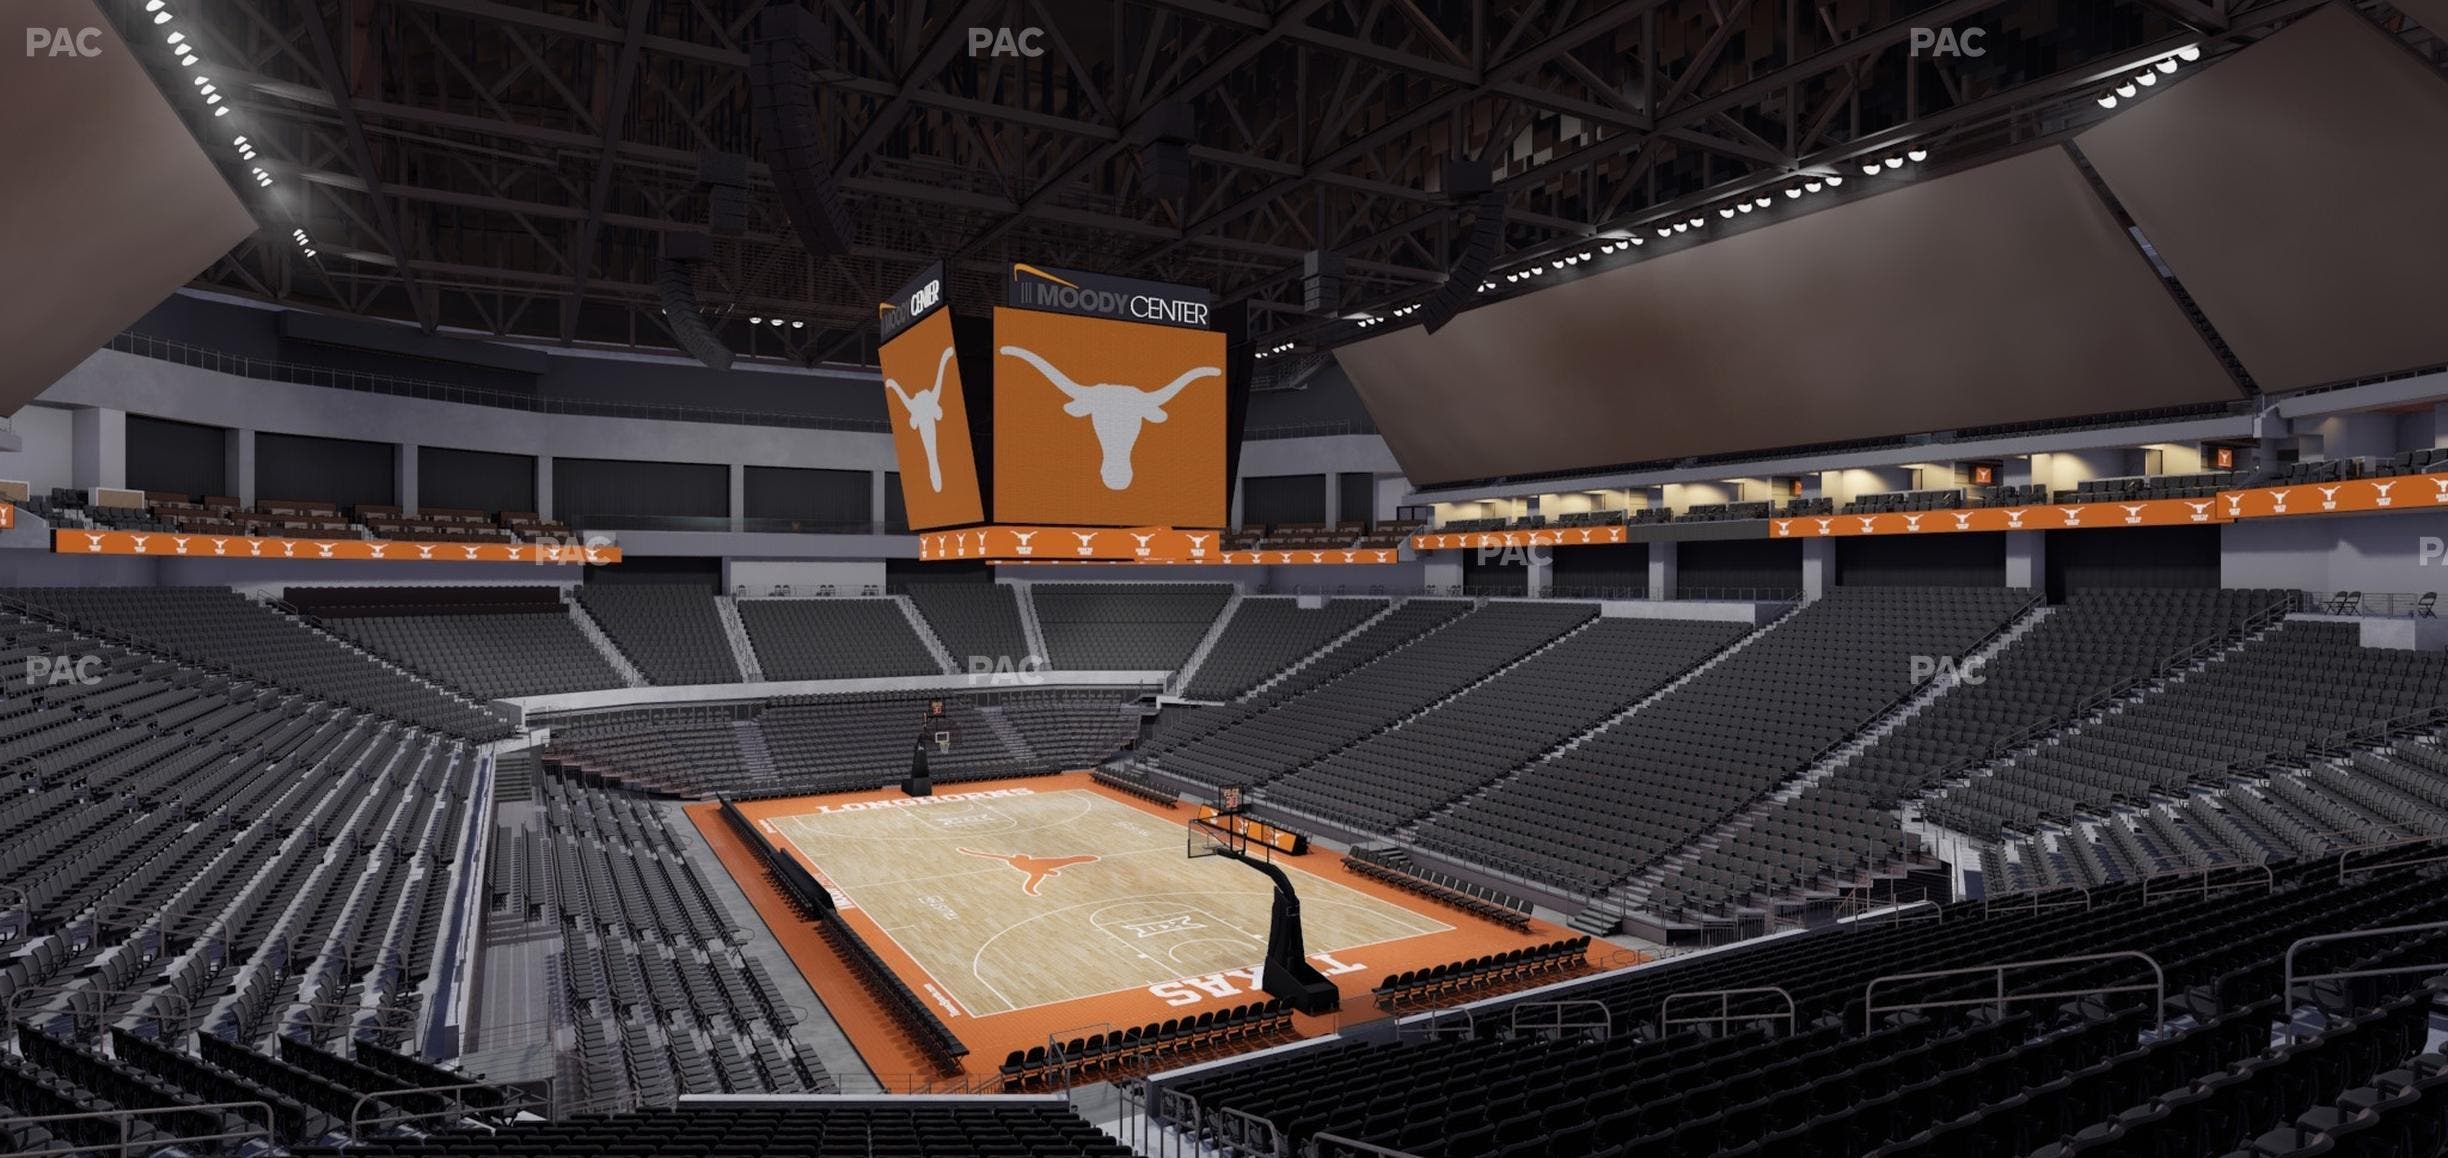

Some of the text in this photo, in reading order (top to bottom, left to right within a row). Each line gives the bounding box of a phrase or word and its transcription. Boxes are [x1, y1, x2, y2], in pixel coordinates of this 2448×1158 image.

[910, 279, 940, 317] CENTER
[1037, 283, 1208, 325] MOODY CENTER
[815, 787, 1035, 814] LONGHORNS
[1148, 954, 1368, 1007] TXAS
